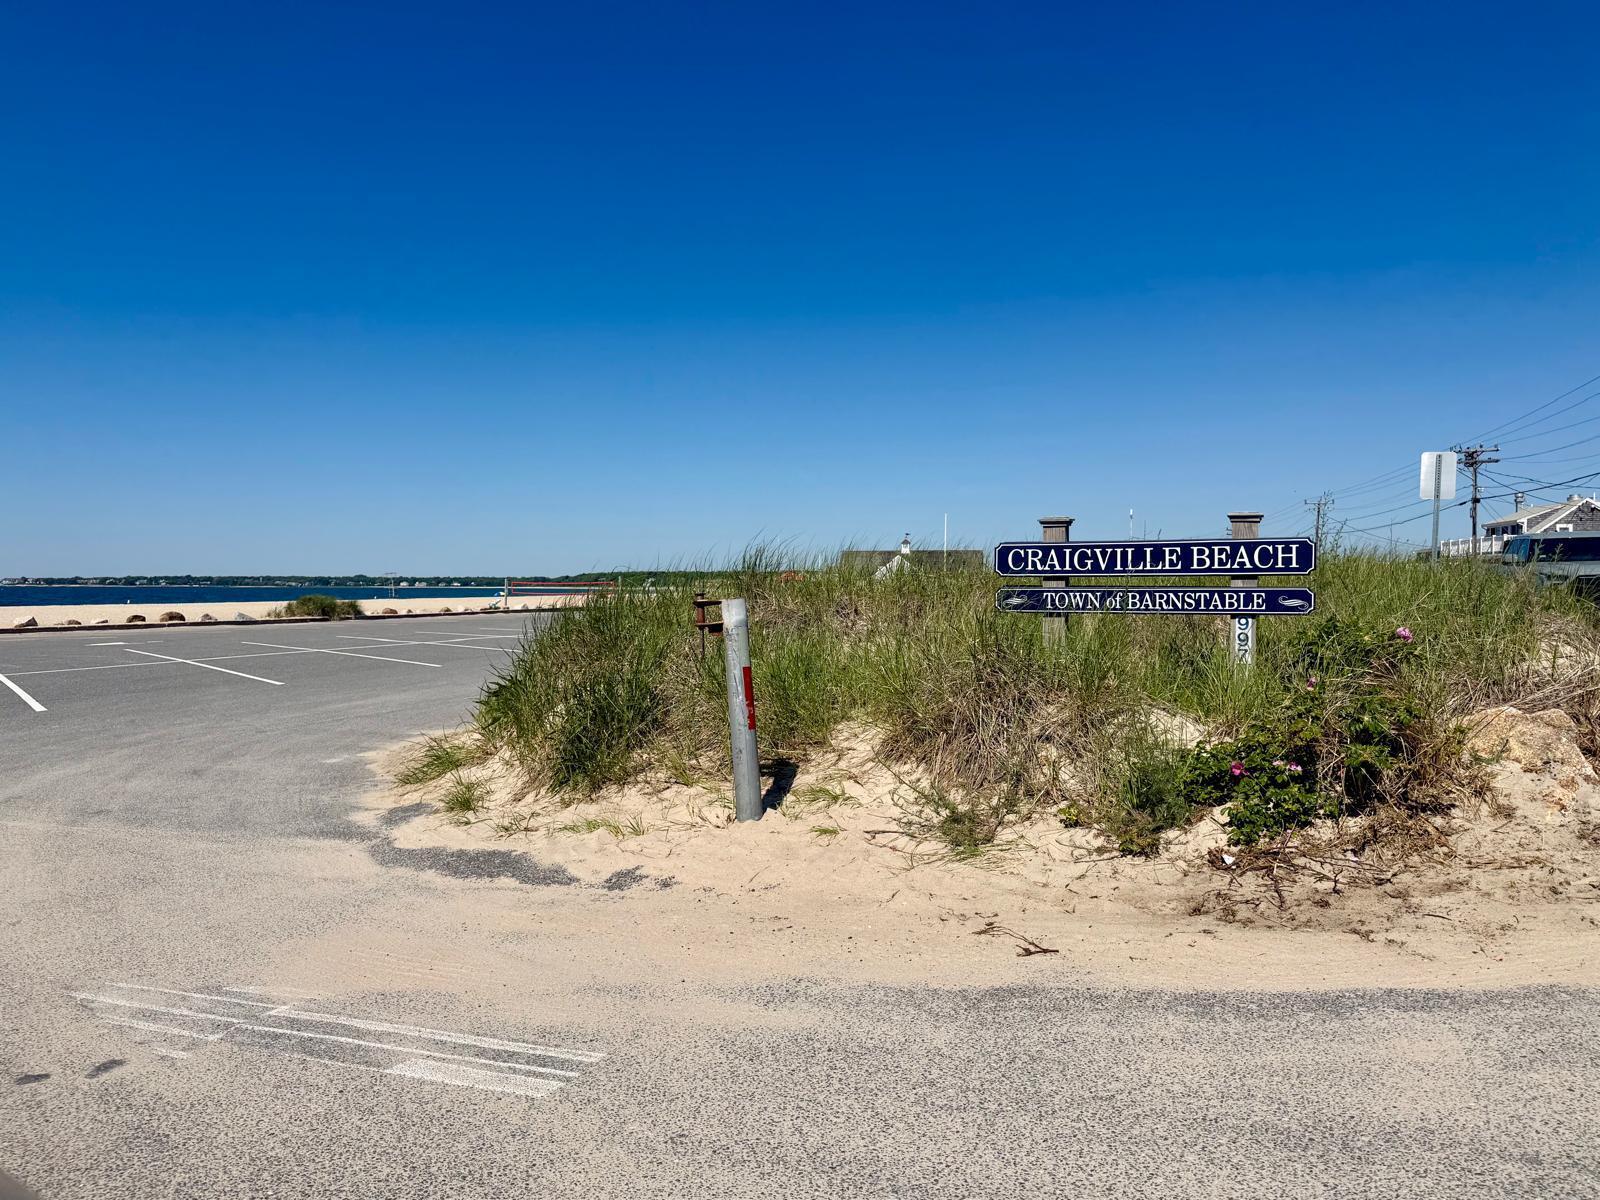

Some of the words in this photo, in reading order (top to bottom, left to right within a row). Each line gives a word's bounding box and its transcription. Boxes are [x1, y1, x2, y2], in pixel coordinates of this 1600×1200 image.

[1007, 547, 1182, 571] CRAIGVILLE
[1190, 544, 1300, 570] BEACH
[1043, 592, 1102, 610] TOWN
[1106, 592, 1125, 610] of
[1127, 592, 1266, 610] BARNSTABLE
